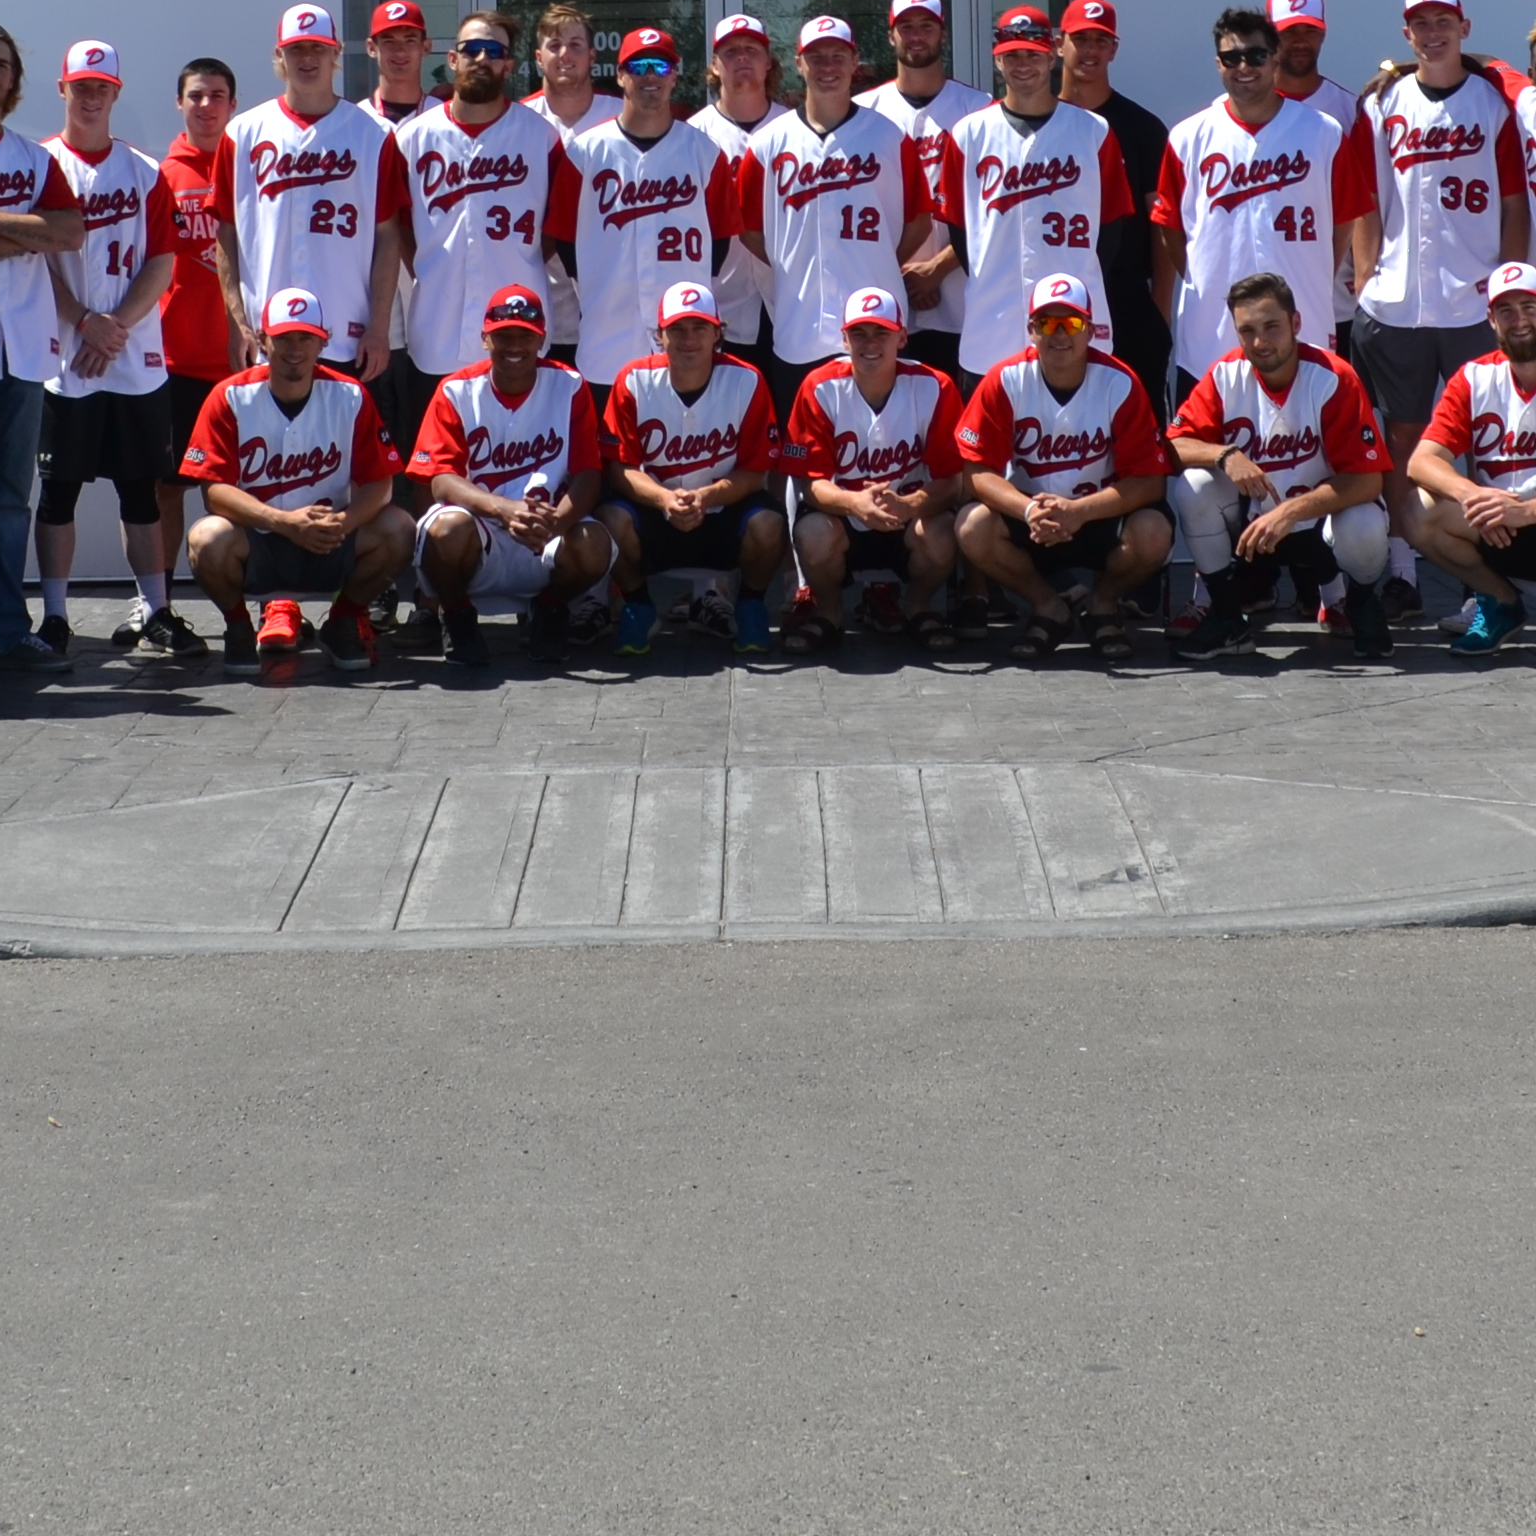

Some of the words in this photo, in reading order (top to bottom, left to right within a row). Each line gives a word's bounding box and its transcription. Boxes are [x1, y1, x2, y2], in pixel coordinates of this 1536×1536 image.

[591, 63, 618, 77] an
[1384, 114, 1486, 159] Dawgs
[250, 140, 357, 186] Dawgs
[416, 151, 529, 196] Dawgs
[772, 152, 881, 196] Dawgs
[975, 154, 1081, 201] Dawgs
[1199, 149, 1311, 197] Dawgs
[592, 168, 698, 214] Dawgs
[1440, 175, 1490, 214] 36
[309, 199, 358, 238] 23
[486, 205, 536, 245] 34
[840, 205, 880, 241] 12
[1042, 212, 1090, 248] 32
[1274, 206, 1317, 241] 42
[106, 240, 134, 279] 14
[657, 226, 703, 262] 20
[467, 425, 564, 471] Dawgs
[638, 418, 739, 463] Dawgs
[1014, 417, 1112, 458] Dawgs
[239, 436, 342, 484] Dawgs
